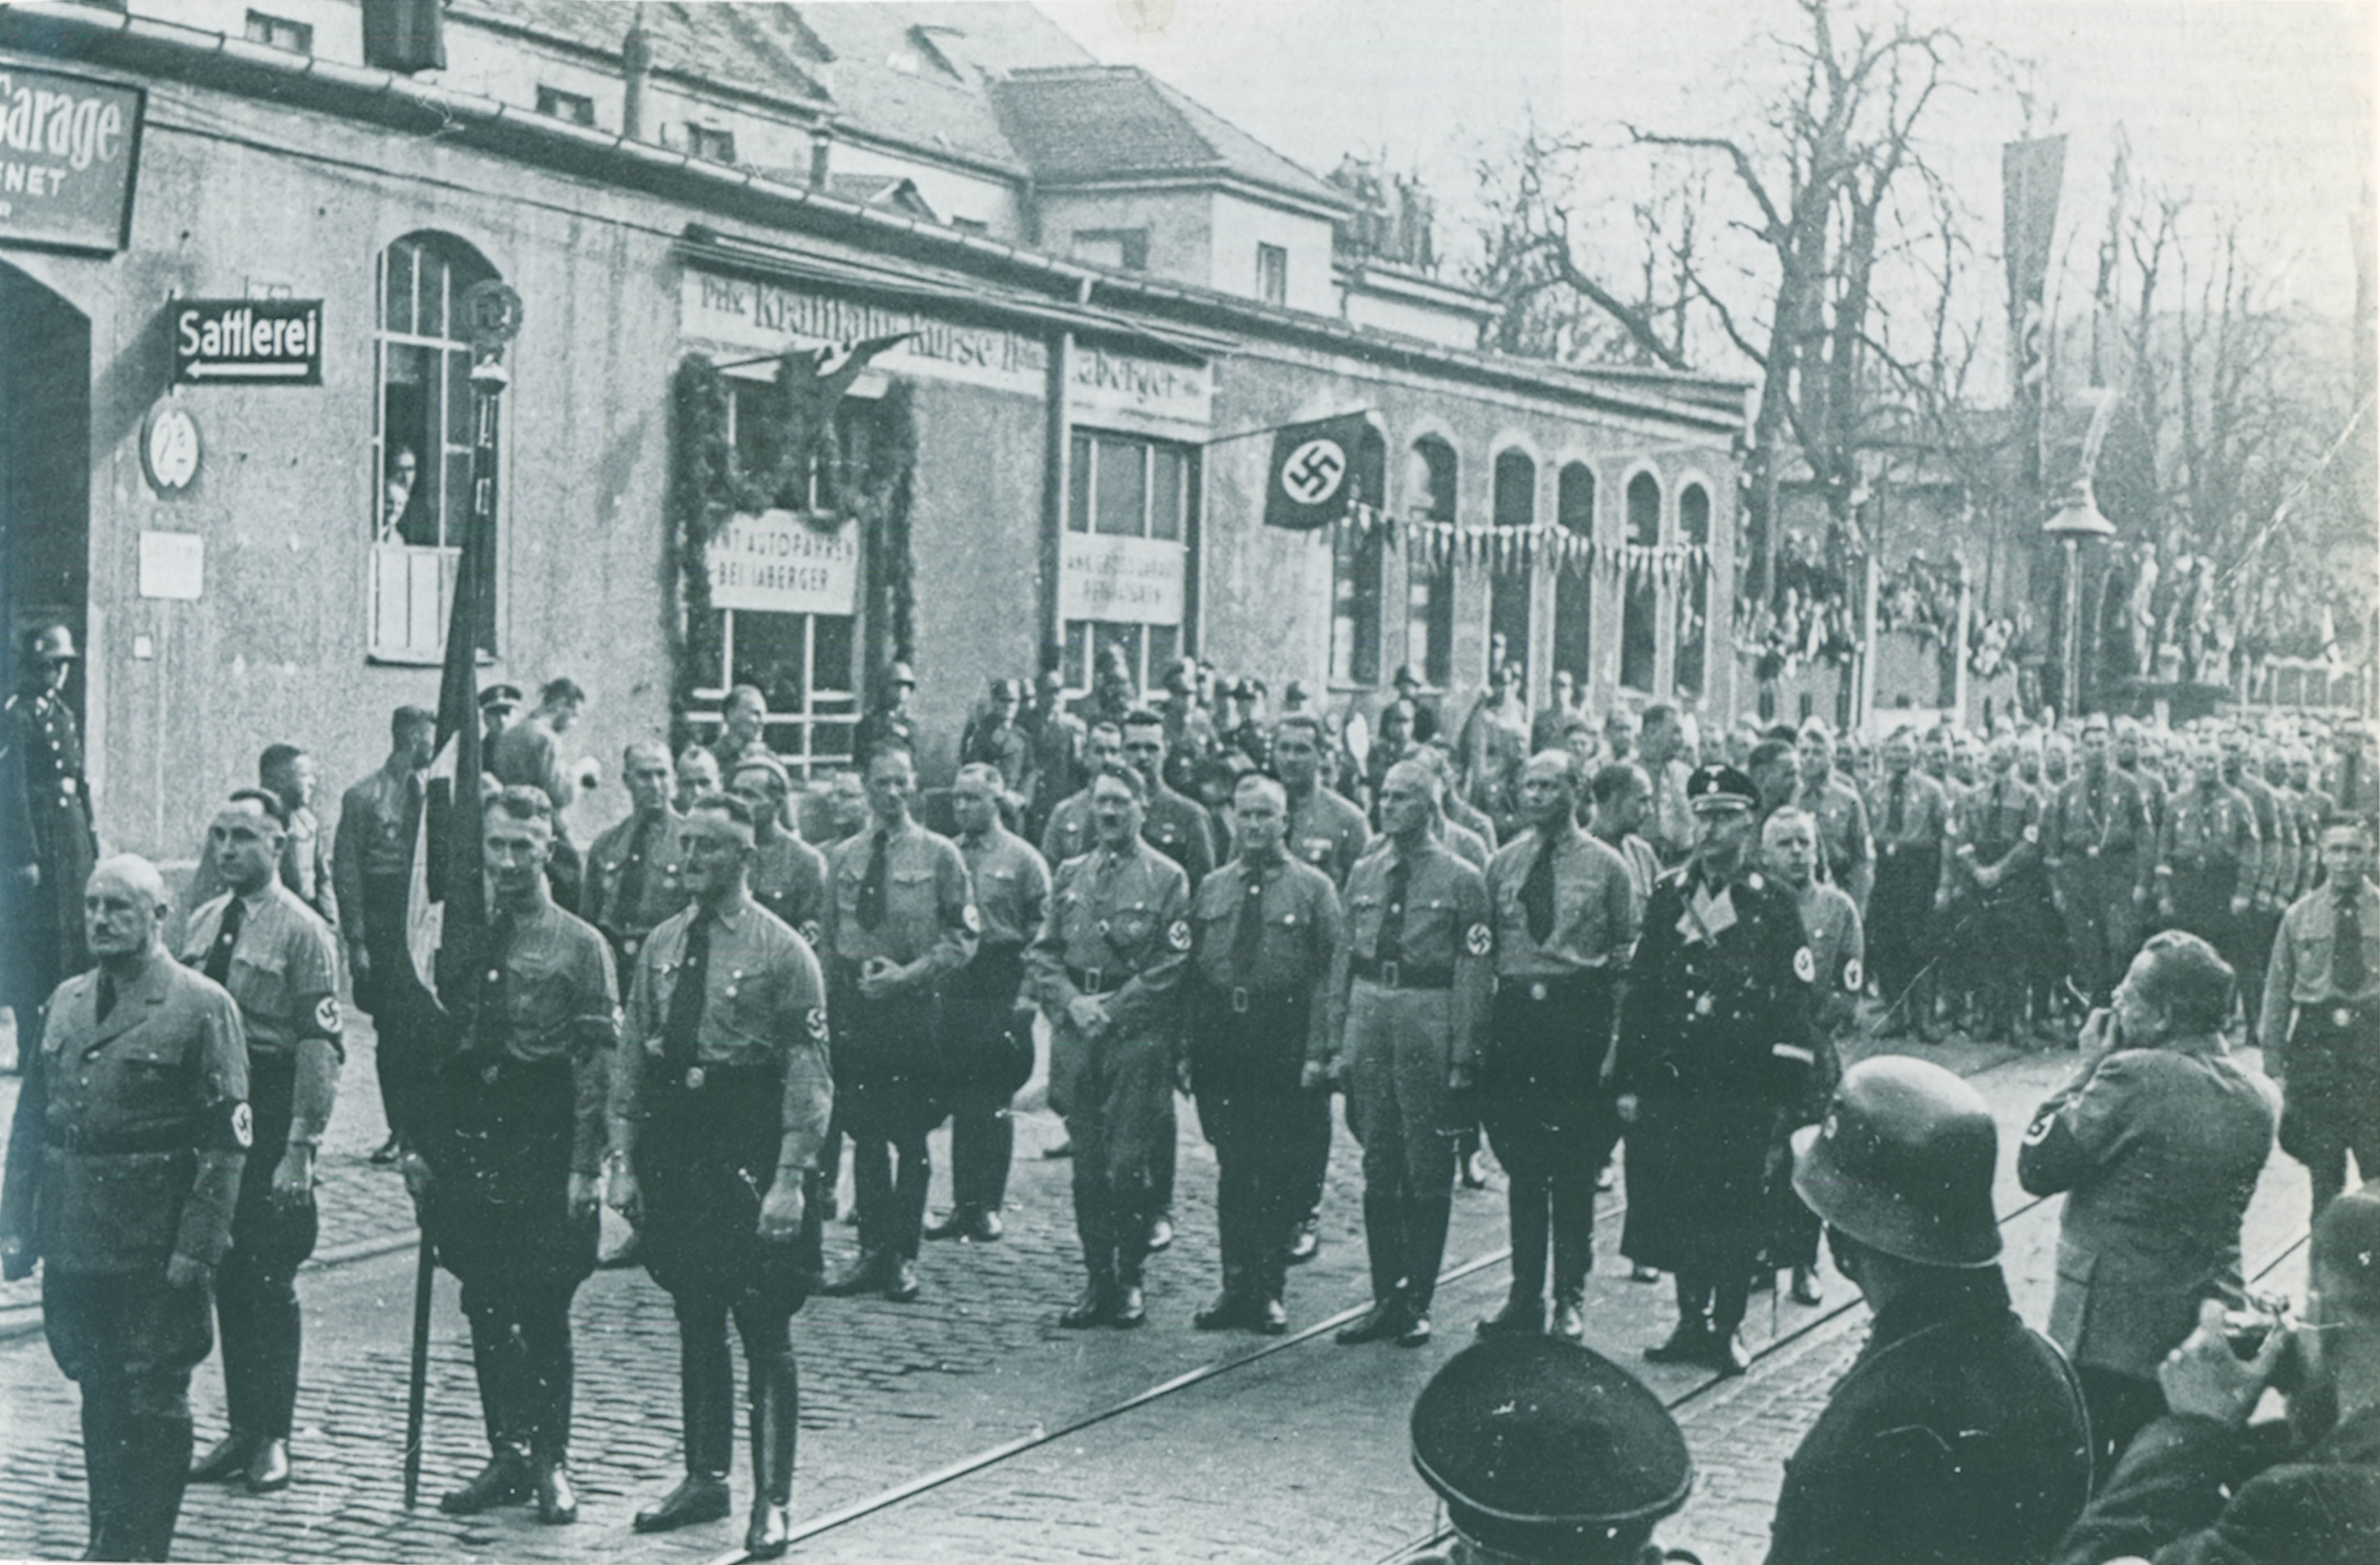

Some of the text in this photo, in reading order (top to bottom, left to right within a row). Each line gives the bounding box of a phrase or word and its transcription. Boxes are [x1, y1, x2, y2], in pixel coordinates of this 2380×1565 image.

[0, 73, 121, 170] arage
[0, 160, 67, 198] NET
[178, 306, 317, 357] Sattlerei
